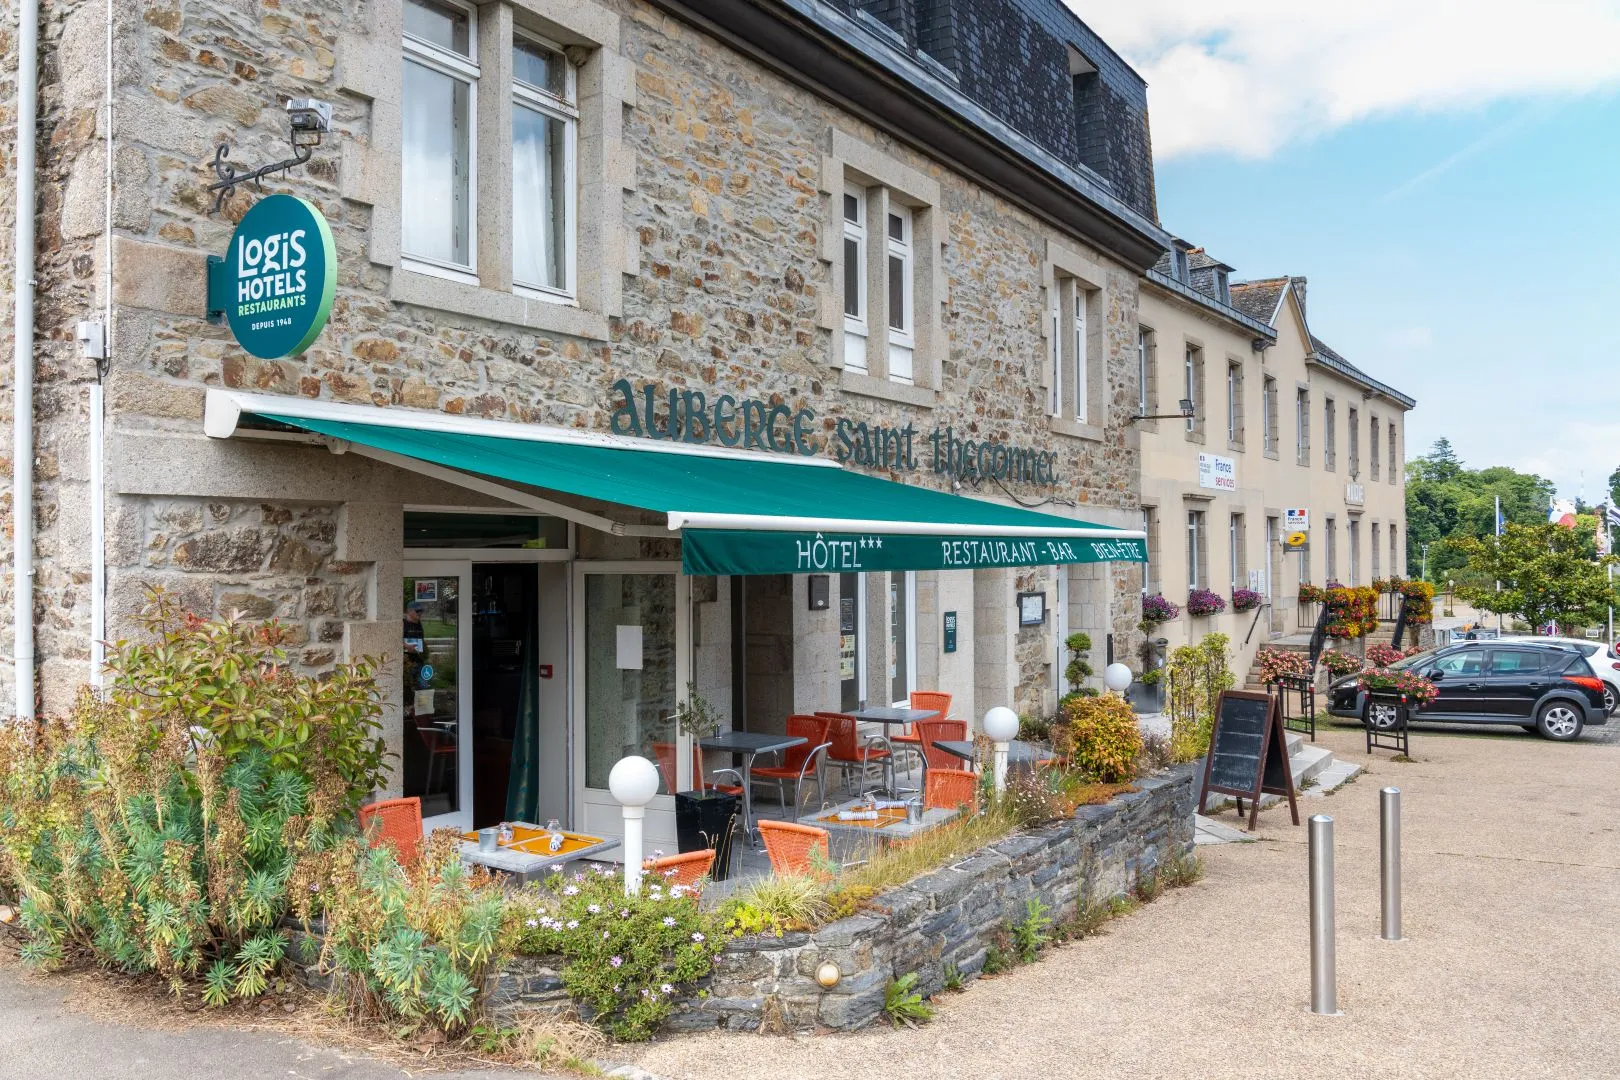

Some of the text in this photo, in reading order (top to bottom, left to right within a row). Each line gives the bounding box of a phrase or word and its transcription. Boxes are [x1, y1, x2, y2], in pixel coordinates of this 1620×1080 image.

[238, 269, 307, 303] HOTELS
[238, 294, 306, 316] RESTAURANTS
[251, 317, 292, 331] DEPUIS 1948
[1215, 458, 1232, 473] France
[1215, 476, 1235, 488] services
[796, 532, 862, 569] HÔTEL
[942, 541, 1039, 565] RESTAURANT
[1047, 542, 1078, 561] BAR
[1090, 538, 1144, 560] BIEN-ÊTRE
